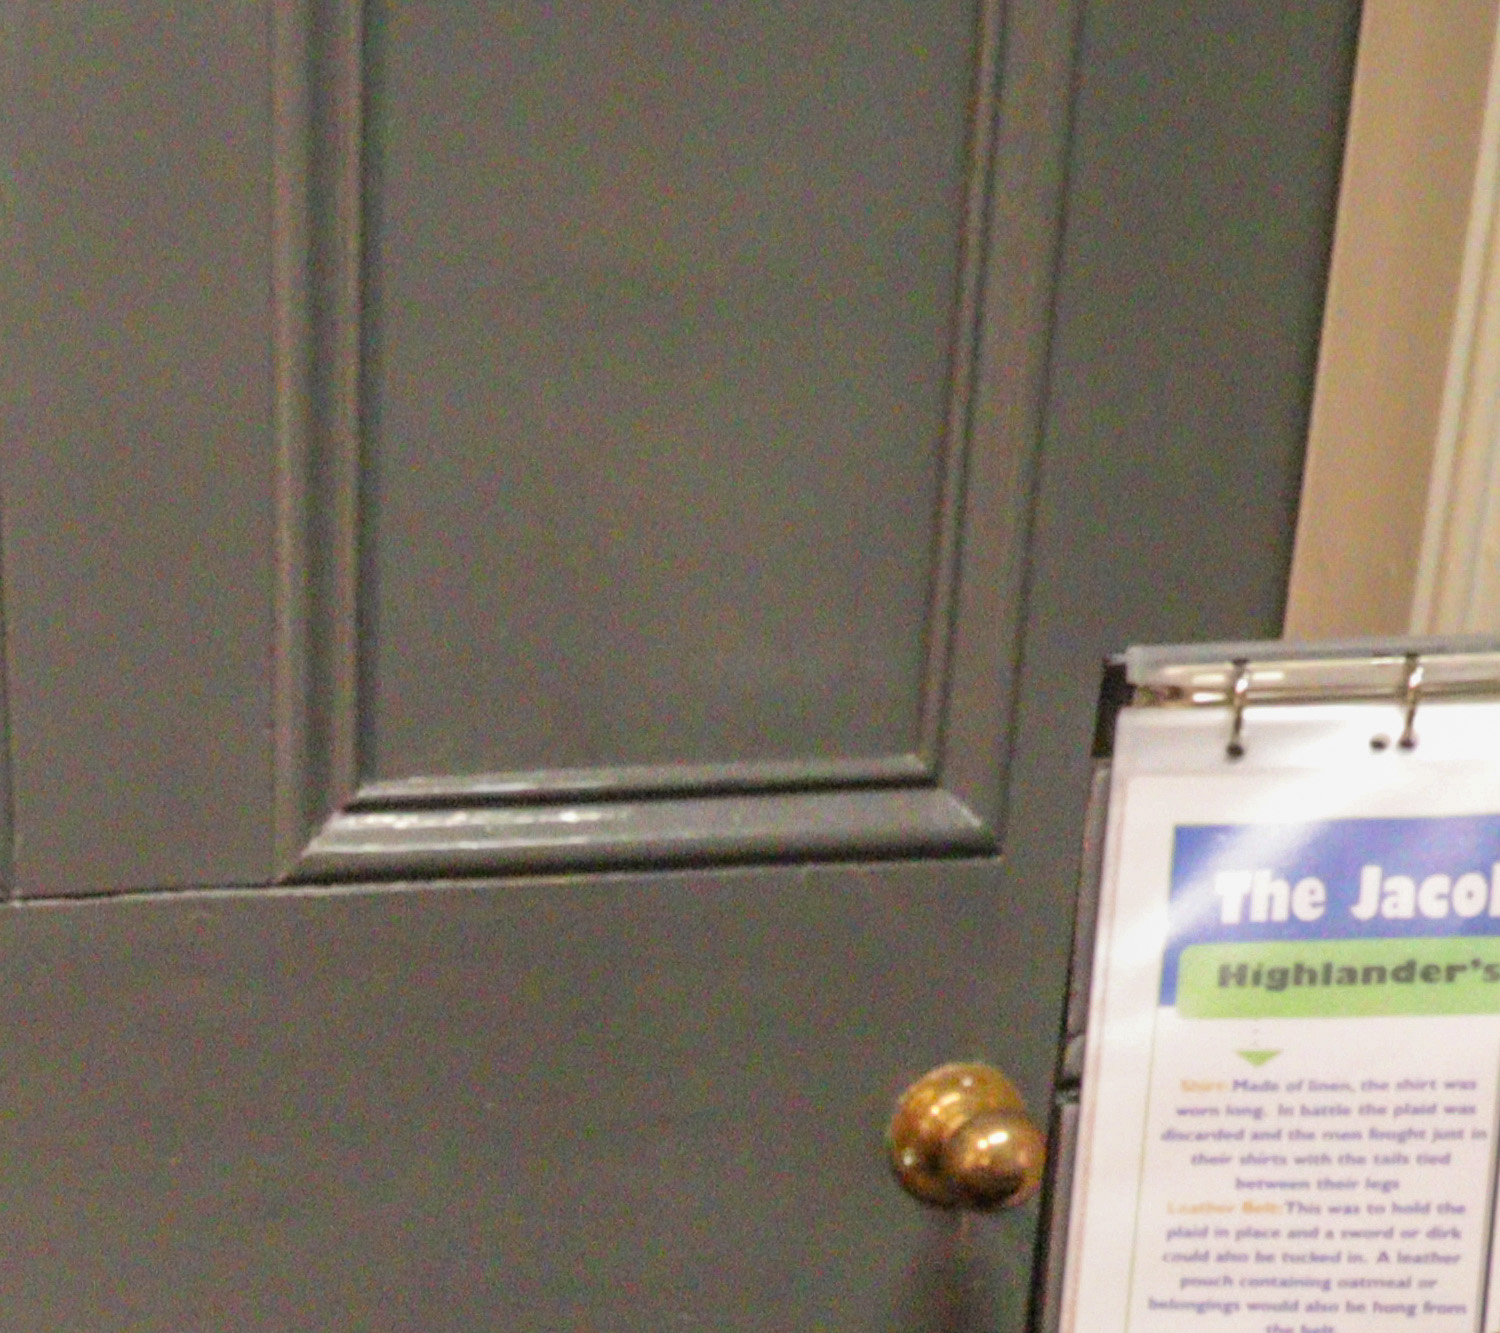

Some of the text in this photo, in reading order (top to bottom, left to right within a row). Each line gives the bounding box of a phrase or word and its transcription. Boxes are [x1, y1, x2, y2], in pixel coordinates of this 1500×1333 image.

[1215, 870, 1326, 925] The
[1218, 957, 1500, 991] Highlander's
[1286, 1080, 1305, 1091] of
[1361, 1080, 1389, 1091] the
[1396, 1080, 1436, 1091] shirt
[1444, 1080, 1477, 1090] was
[1286, 1201, 1466, 1214] This was to hold the
